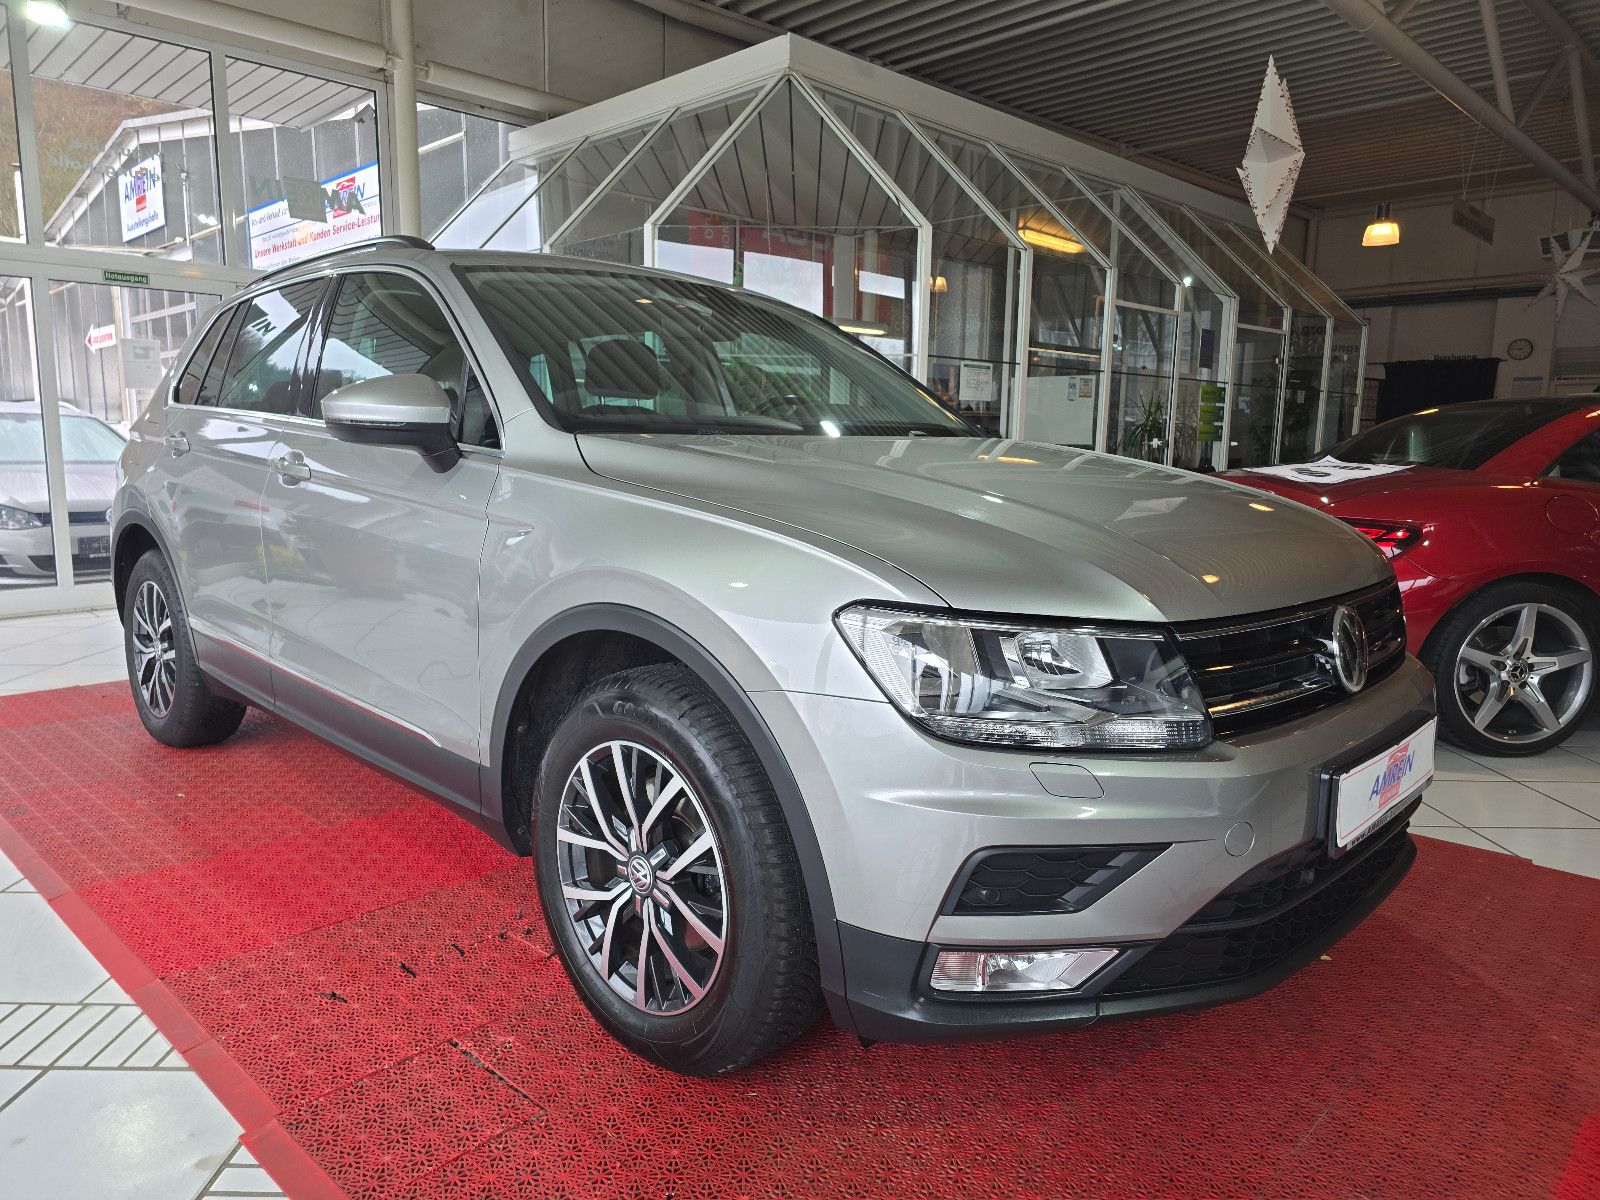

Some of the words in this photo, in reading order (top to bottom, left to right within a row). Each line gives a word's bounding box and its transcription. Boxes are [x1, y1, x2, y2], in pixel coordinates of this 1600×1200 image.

[124, 167, 156, 204] AMREIN
[254, 246, 271, 259] Unsere
[310, 228, 331, 243] Kunden
[105, 271, 147, 284] Notausgang
[1369, 749, 1416, 801] AMREIN
